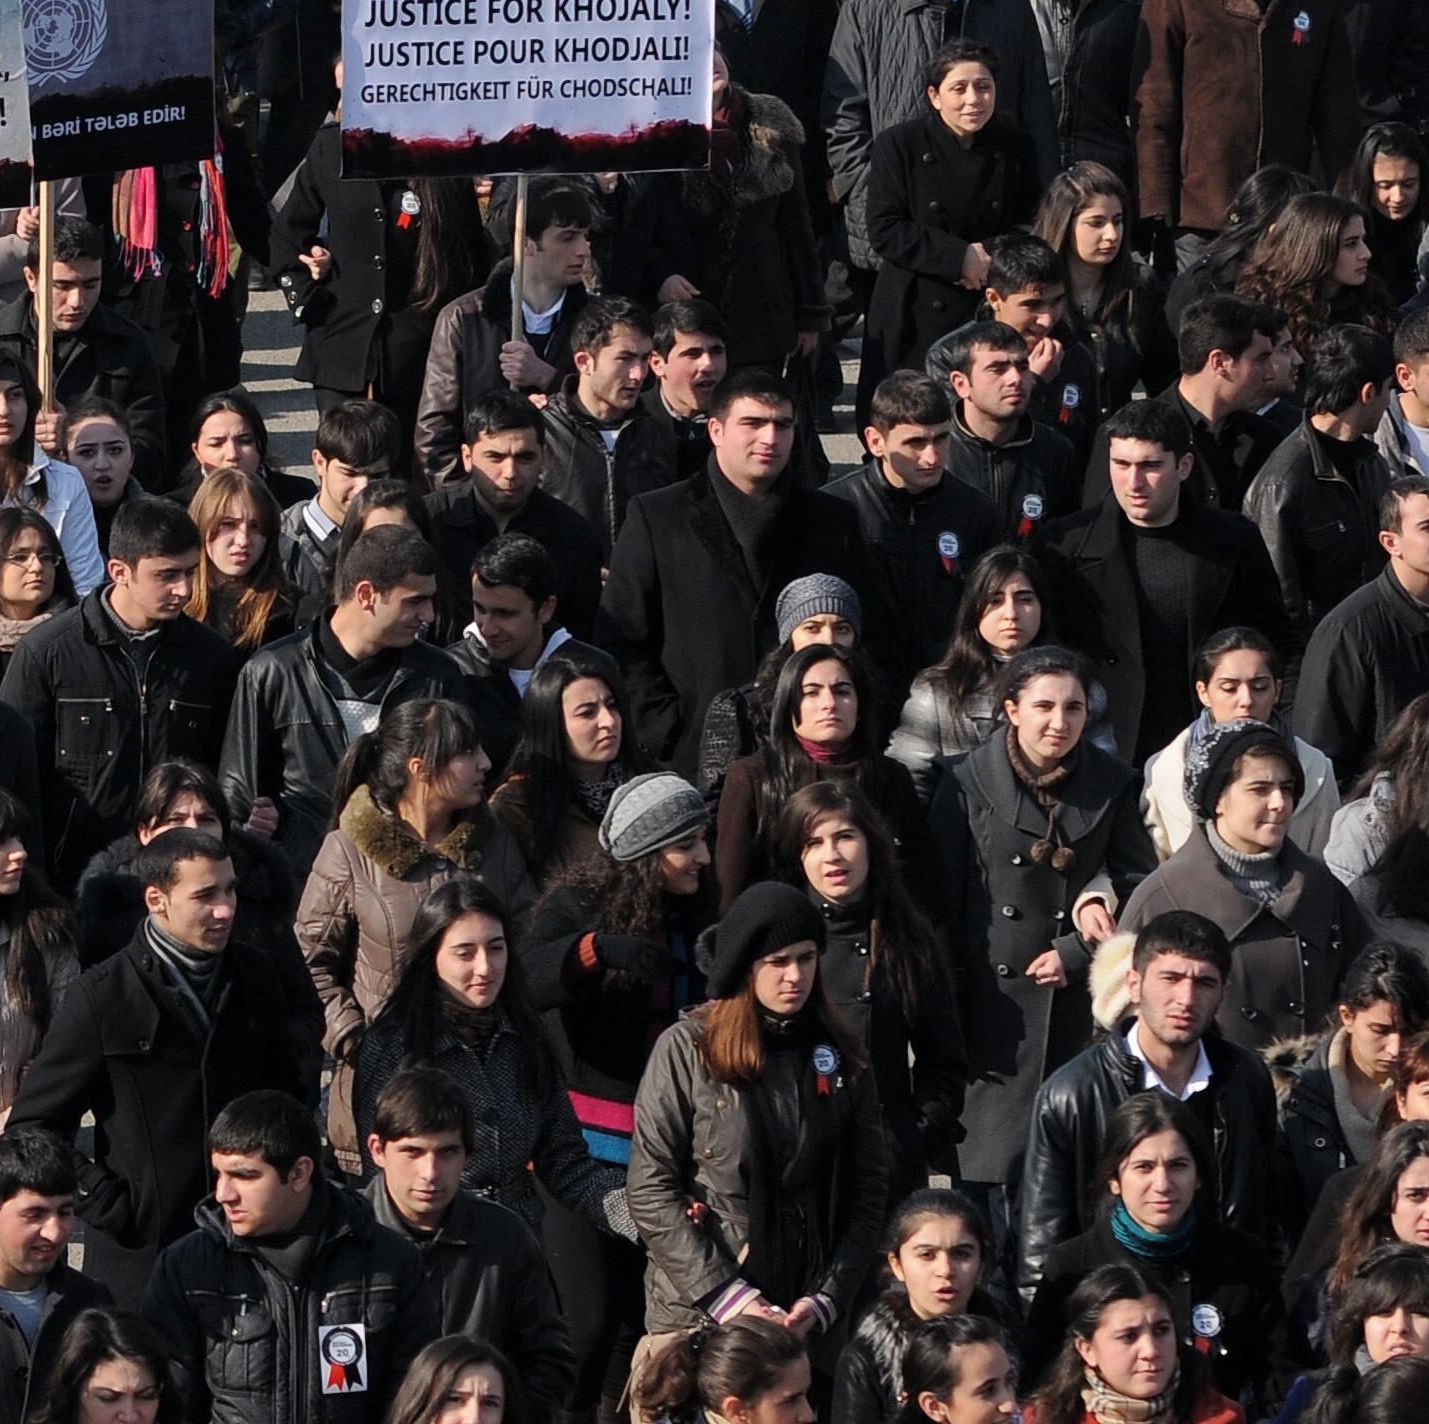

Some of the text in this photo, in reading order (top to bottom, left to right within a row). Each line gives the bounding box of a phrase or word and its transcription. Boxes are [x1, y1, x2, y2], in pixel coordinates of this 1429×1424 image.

[364, 36, 689, 67] JUSTICE POUR KHODJALI!
[361, 75, 692, 104] GERECHTIGKEIT FÜR CHODSCHALI!
[42, 116, 81, 137] BƏRİ
[85, 111, 139, 130] TƏLƏB
[143, 106, 186, 124] EDİR!
